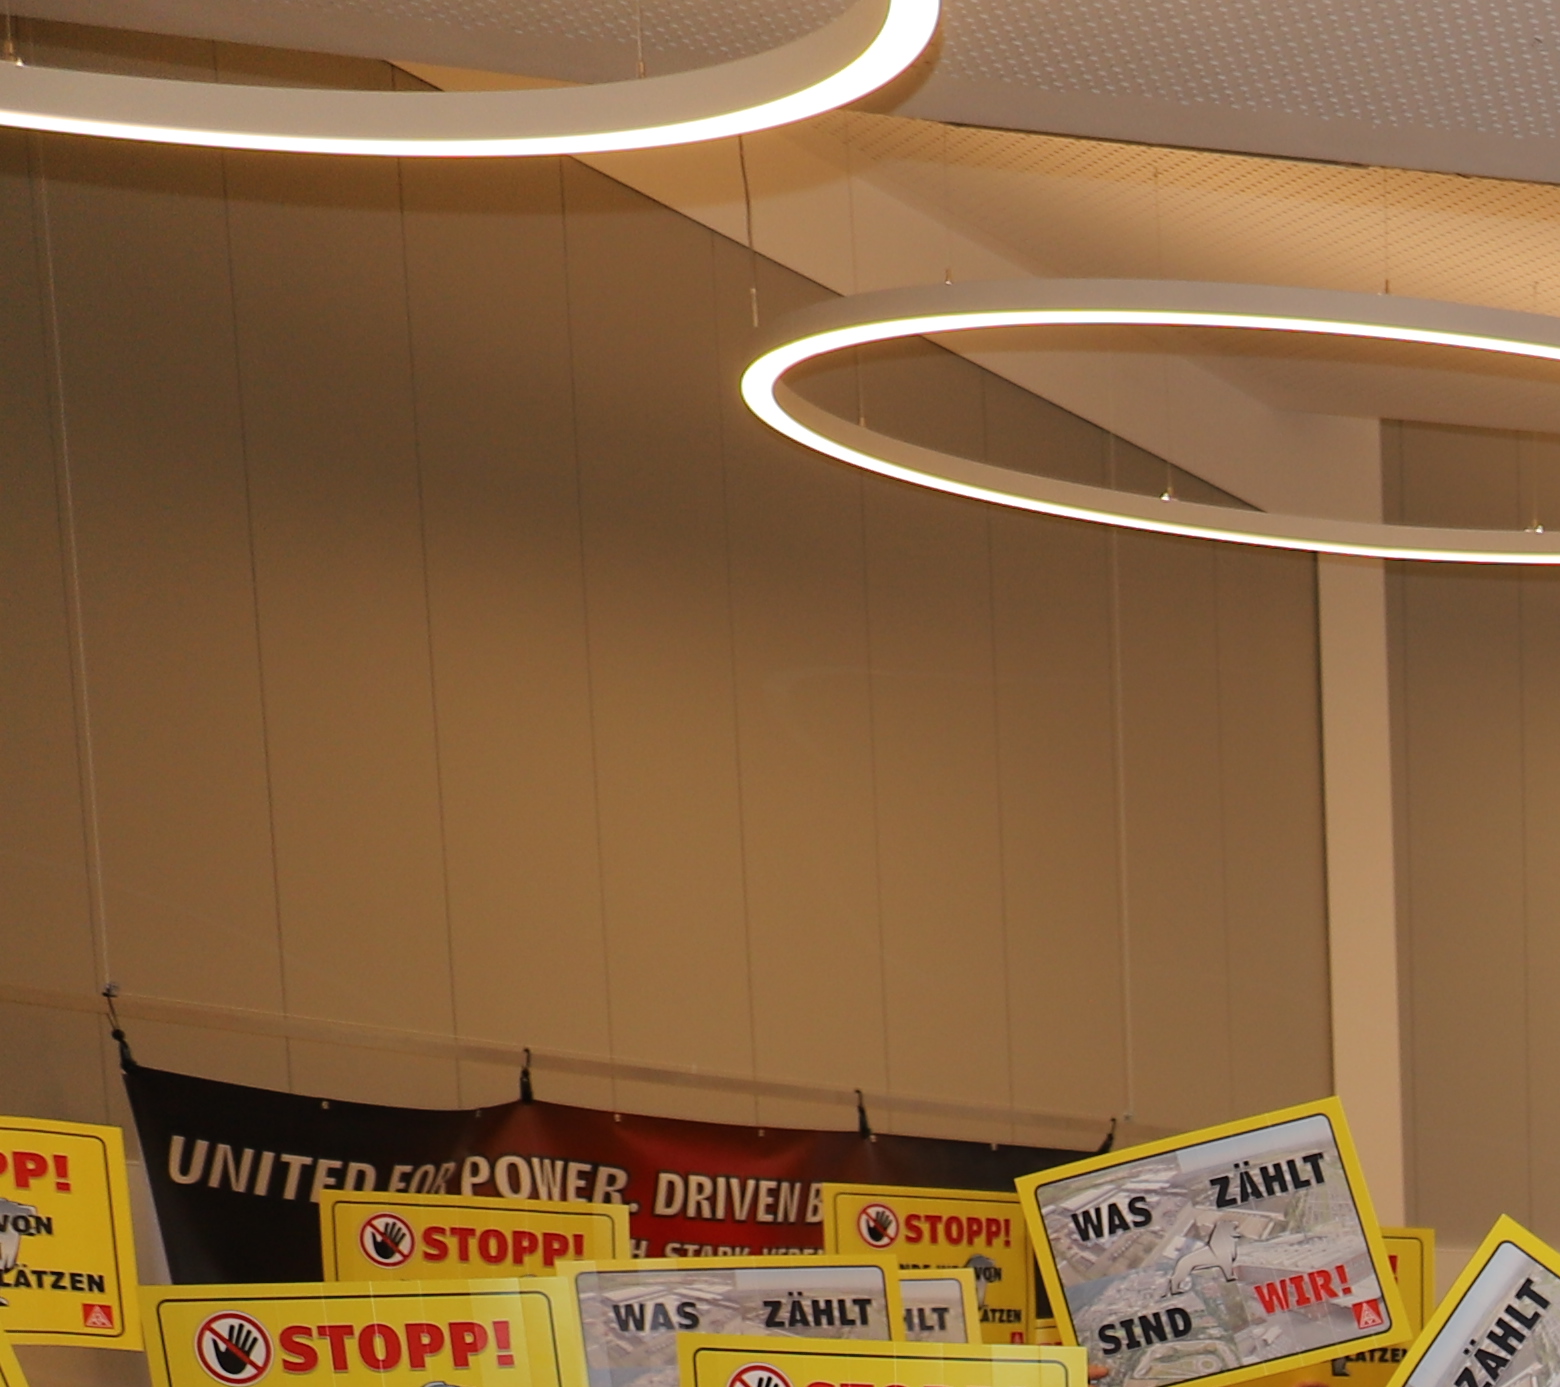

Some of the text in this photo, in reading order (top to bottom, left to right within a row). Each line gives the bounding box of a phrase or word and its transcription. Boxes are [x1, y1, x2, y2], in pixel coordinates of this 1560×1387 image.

[655, 1172, 797, 1224] DRIVEN
[1070, 1152, 1327, 1243] WAS ZÄHLT
[422, 1226, 584, 1268] STOPP!
[904, 1213, 1012, 1248] STOPP!
[613, 1301, 700, 1333] WAS
[762, 1293, 872, 1329] ZÄHLT
[1098, 1264, 1353, 1356] SIND WIR!
[279, 1321, 516, 1375] STOPP!
